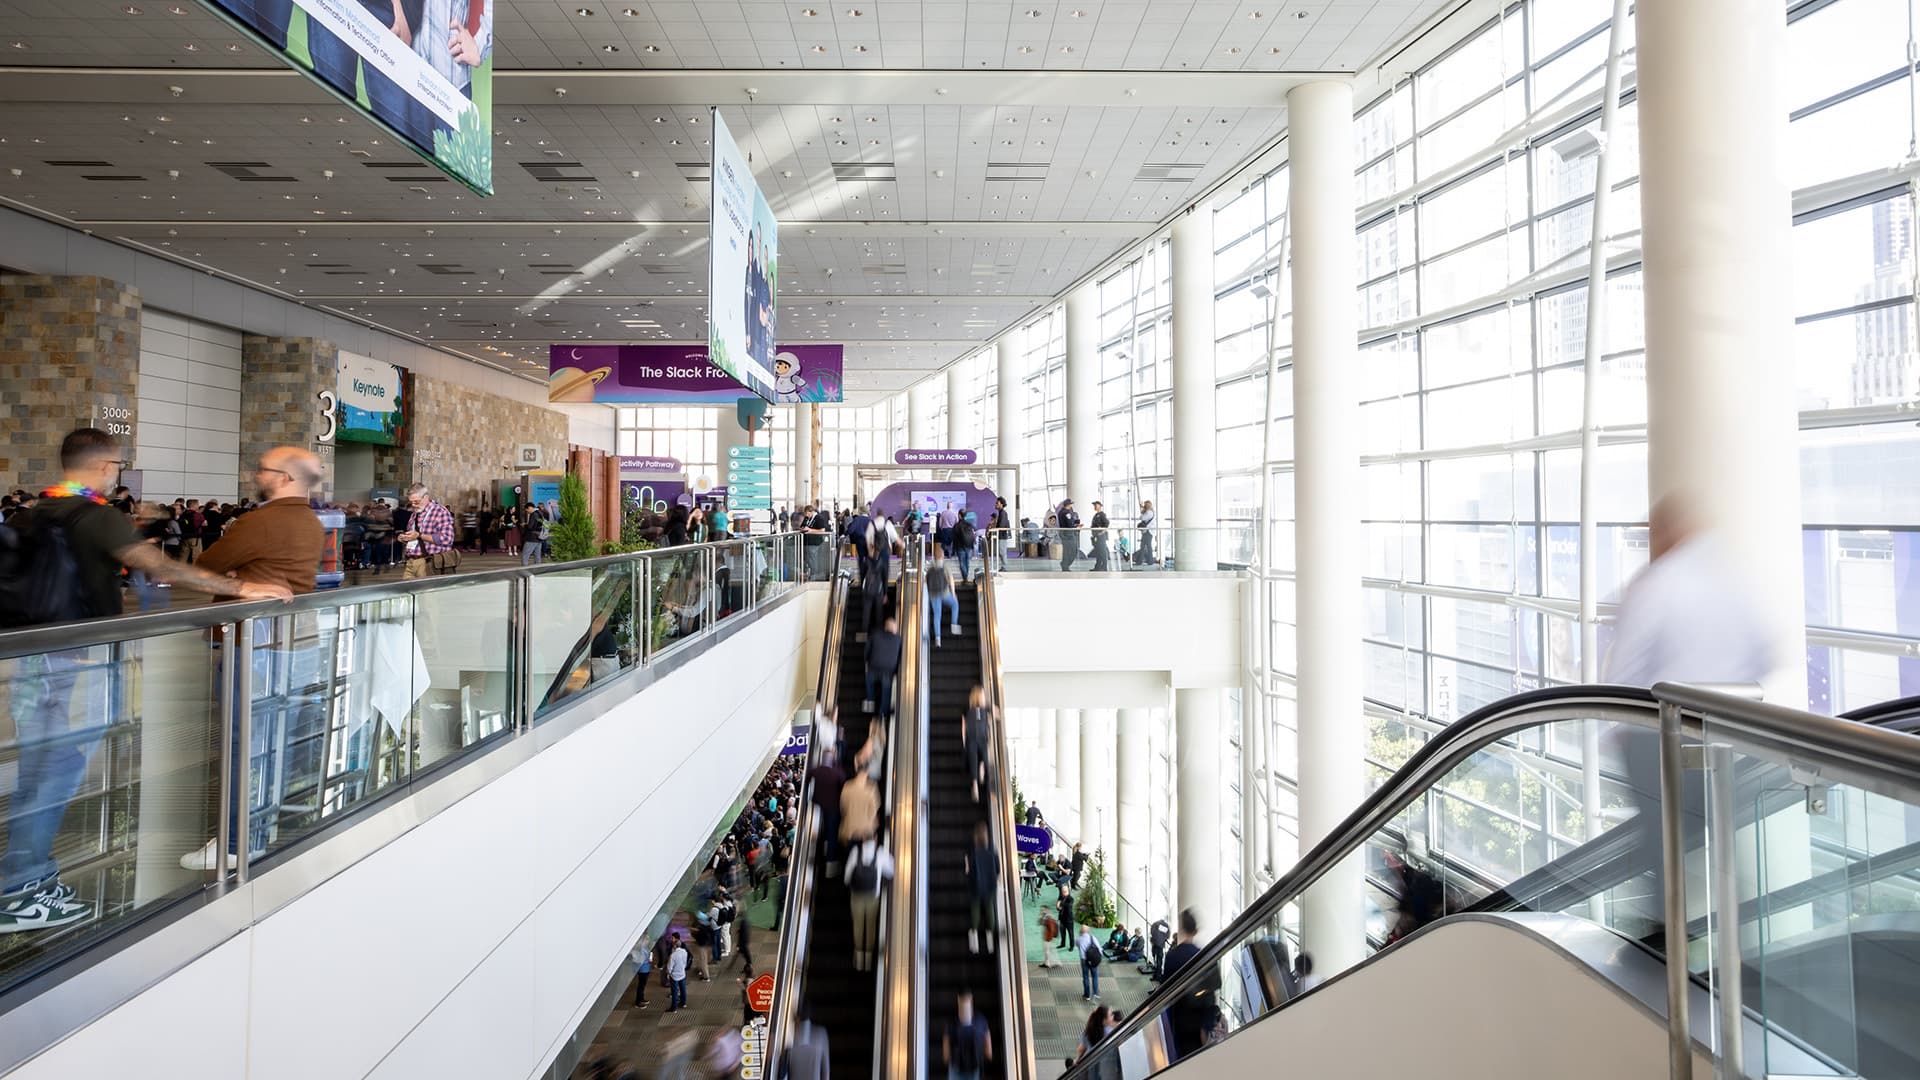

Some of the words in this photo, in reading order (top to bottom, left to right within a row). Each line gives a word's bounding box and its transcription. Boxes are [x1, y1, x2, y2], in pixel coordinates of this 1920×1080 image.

[639, 366, 663, 378] The
[666, 366, 702, 378] Slack
[352, 377, 385, 399] Keynote
[102, 406, 132, 420] 3000-
[317, 390, 336, 442] 3
[107, 423, 131, 436] 3012
[645, 460, 675, 470] Pathway
[1017, 833, 1040, 845] Waves
